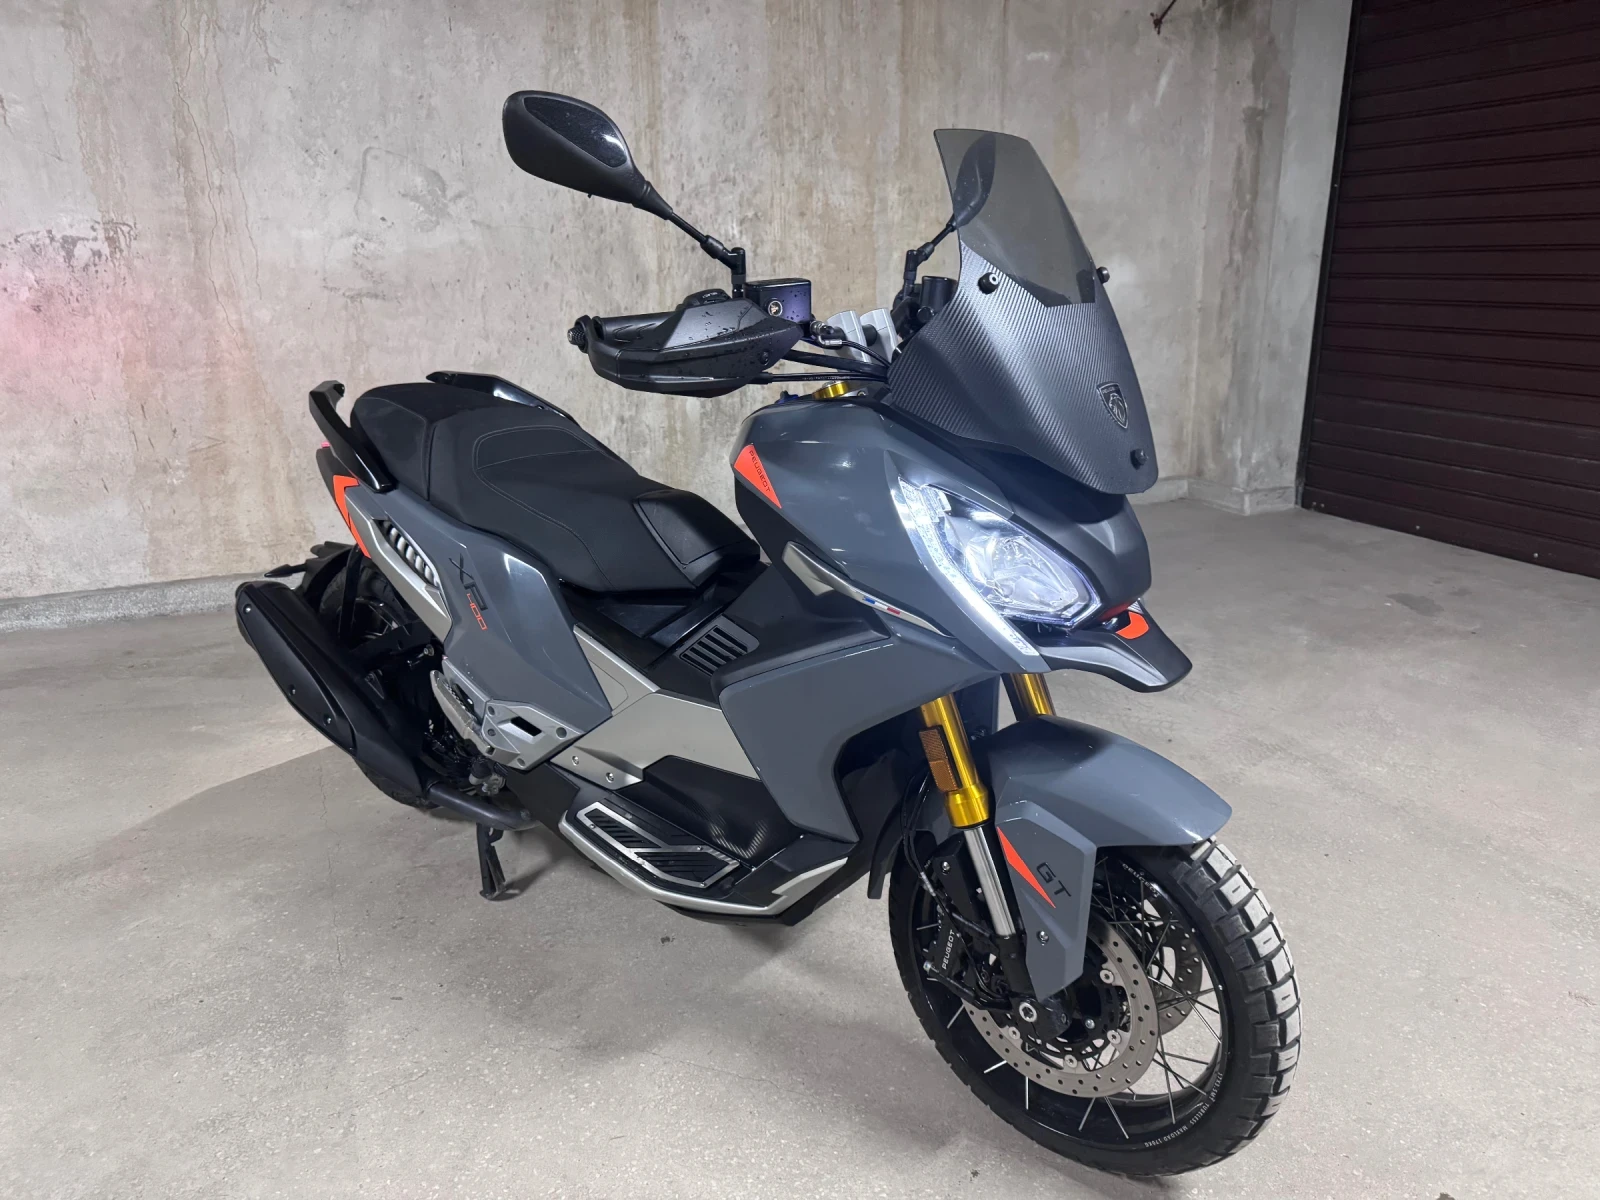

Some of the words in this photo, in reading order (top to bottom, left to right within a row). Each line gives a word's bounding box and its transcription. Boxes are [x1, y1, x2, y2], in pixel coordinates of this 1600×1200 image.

[749, 450, 771, 492] PEUGEOT
[448, 553, 488, 612] XP
[466, 593, 488, 631] 400
[1036, 862, 1072, 897] GT
[941, 929, 955, 970] PEUGEOT
[1189, 1103, 1210, 1125] TUBELESS
[1163, 1125, 1188, 1142] MAXLOAD
